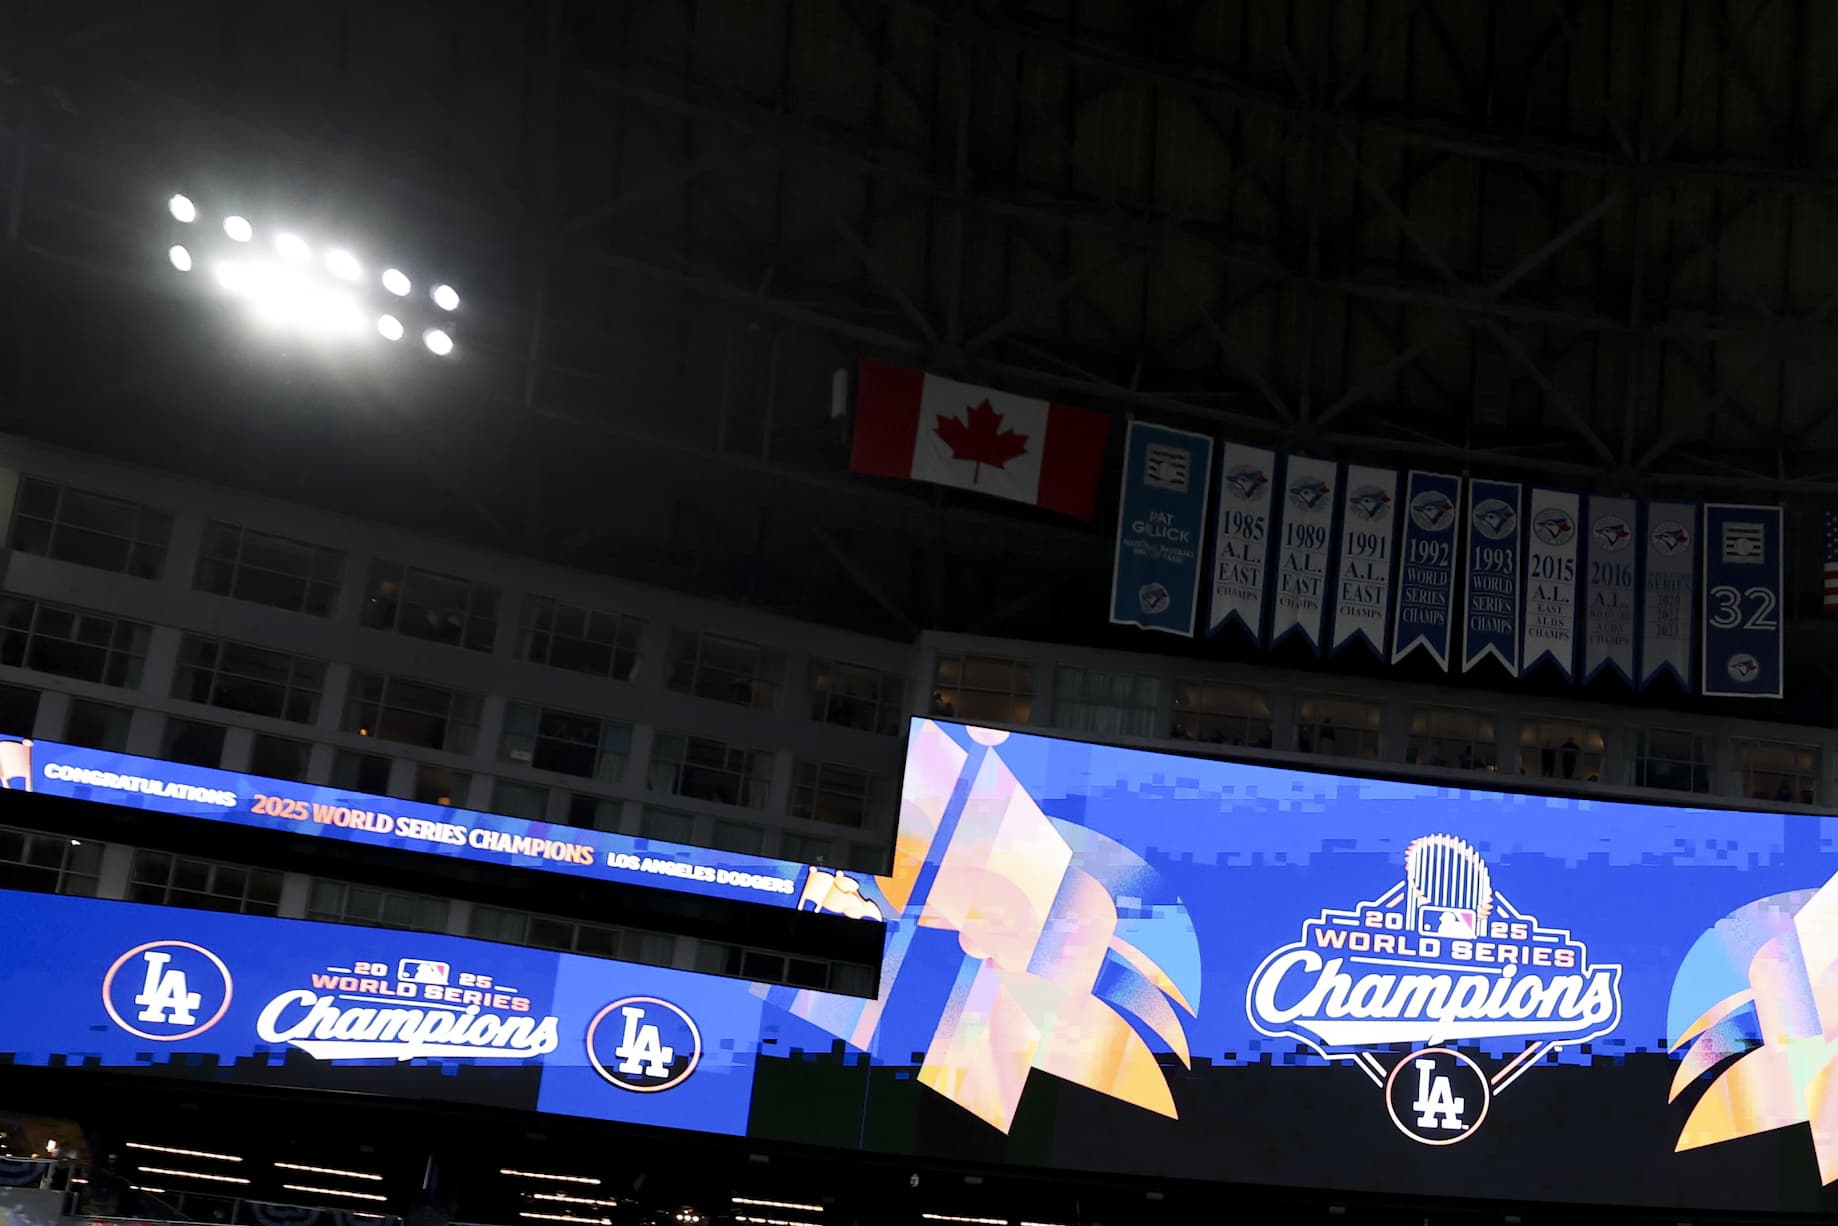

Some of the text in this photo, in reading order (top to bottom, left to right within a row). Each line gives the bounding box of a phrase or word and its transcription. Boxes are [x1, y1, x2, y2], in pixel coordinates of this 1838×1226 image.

[1223, 511, 1264, 540] 1985
[1286, 524, 1325, 549] 1989
[1221, 542, 1260, 563] A.L.
[1347, 532, 1386, 559] 1991
[1409, 539, 1449, 567] 1992
[1283, 554, 1321, 573] A.L.
[1345, 562, 1385, 582] A.L.
[1474, 546, 1513, 574] 1993
[1532, 554, 1574, 582] 2015
[1591, 561, 1632, 586] 2016
[1219, 563, 1260, 586] EAST
[1282, 574, 1321, 595] EAST
[1407, 568, 1448, 585] WORLD
[1472, 576, 1513, 594] WORLD
[1343, 583, 1383, 605] EAST
[1405, 587, 1446, 605] SERIES
[1472, 596, 1512, 614] SERIES
[1709, 584, 1777, 631] 32
[1403, 607, 1445, 625] CHAMPS
[1470, 615, 1512, 633] CHAMPS
[44, 763, 237, 807] CONGRATULATIONS
[250, 794, 595, 865] 2025 WORLD SERIES CHAMPIONS
[607, 852, 795, 895] LOS ANGELES DODGERS
[1365, 911, 1528, 940] 20 25
[1314, 928, 1575, 967] WORLD SERIES
[135, 951, 201, 1026] LA
[354, 961, 493, 989] 20 25
[311, 973, 530, 1012] WORLD SERIES
[1255, 950, 1613, 1046] Champions
[256, 989, 559, 1061] Champions
[615, 1006, 674, 1078] LA
[1413, 1059, 1464, 1129] LA
